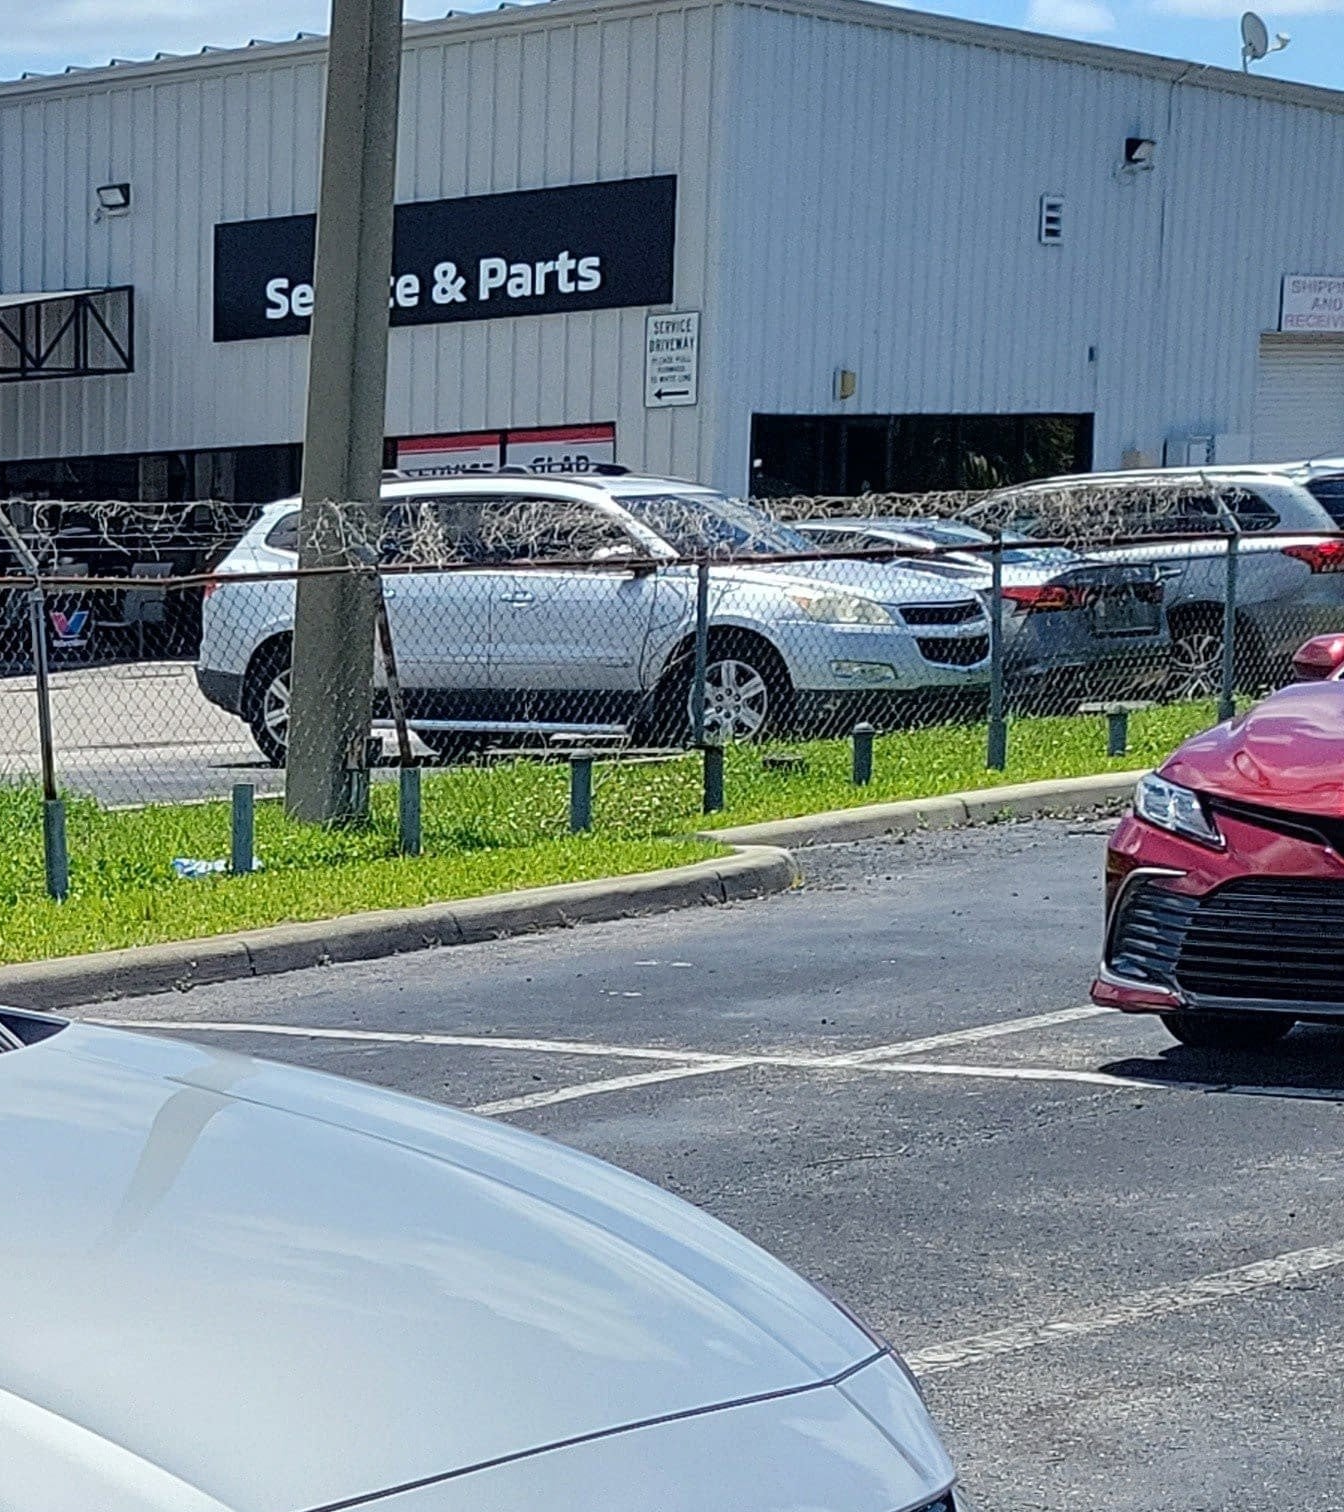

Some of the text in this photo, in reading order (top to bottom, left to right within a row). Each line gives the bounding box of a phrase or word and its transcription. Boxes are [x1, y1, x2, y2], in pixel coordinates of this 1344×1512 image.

[432, 261, 467, 304] &
[479, 250, 601, 300] Parts
[653, 318, 692, 335] SERVICE
[649, 337, 694, 353] DRIVEWAY
